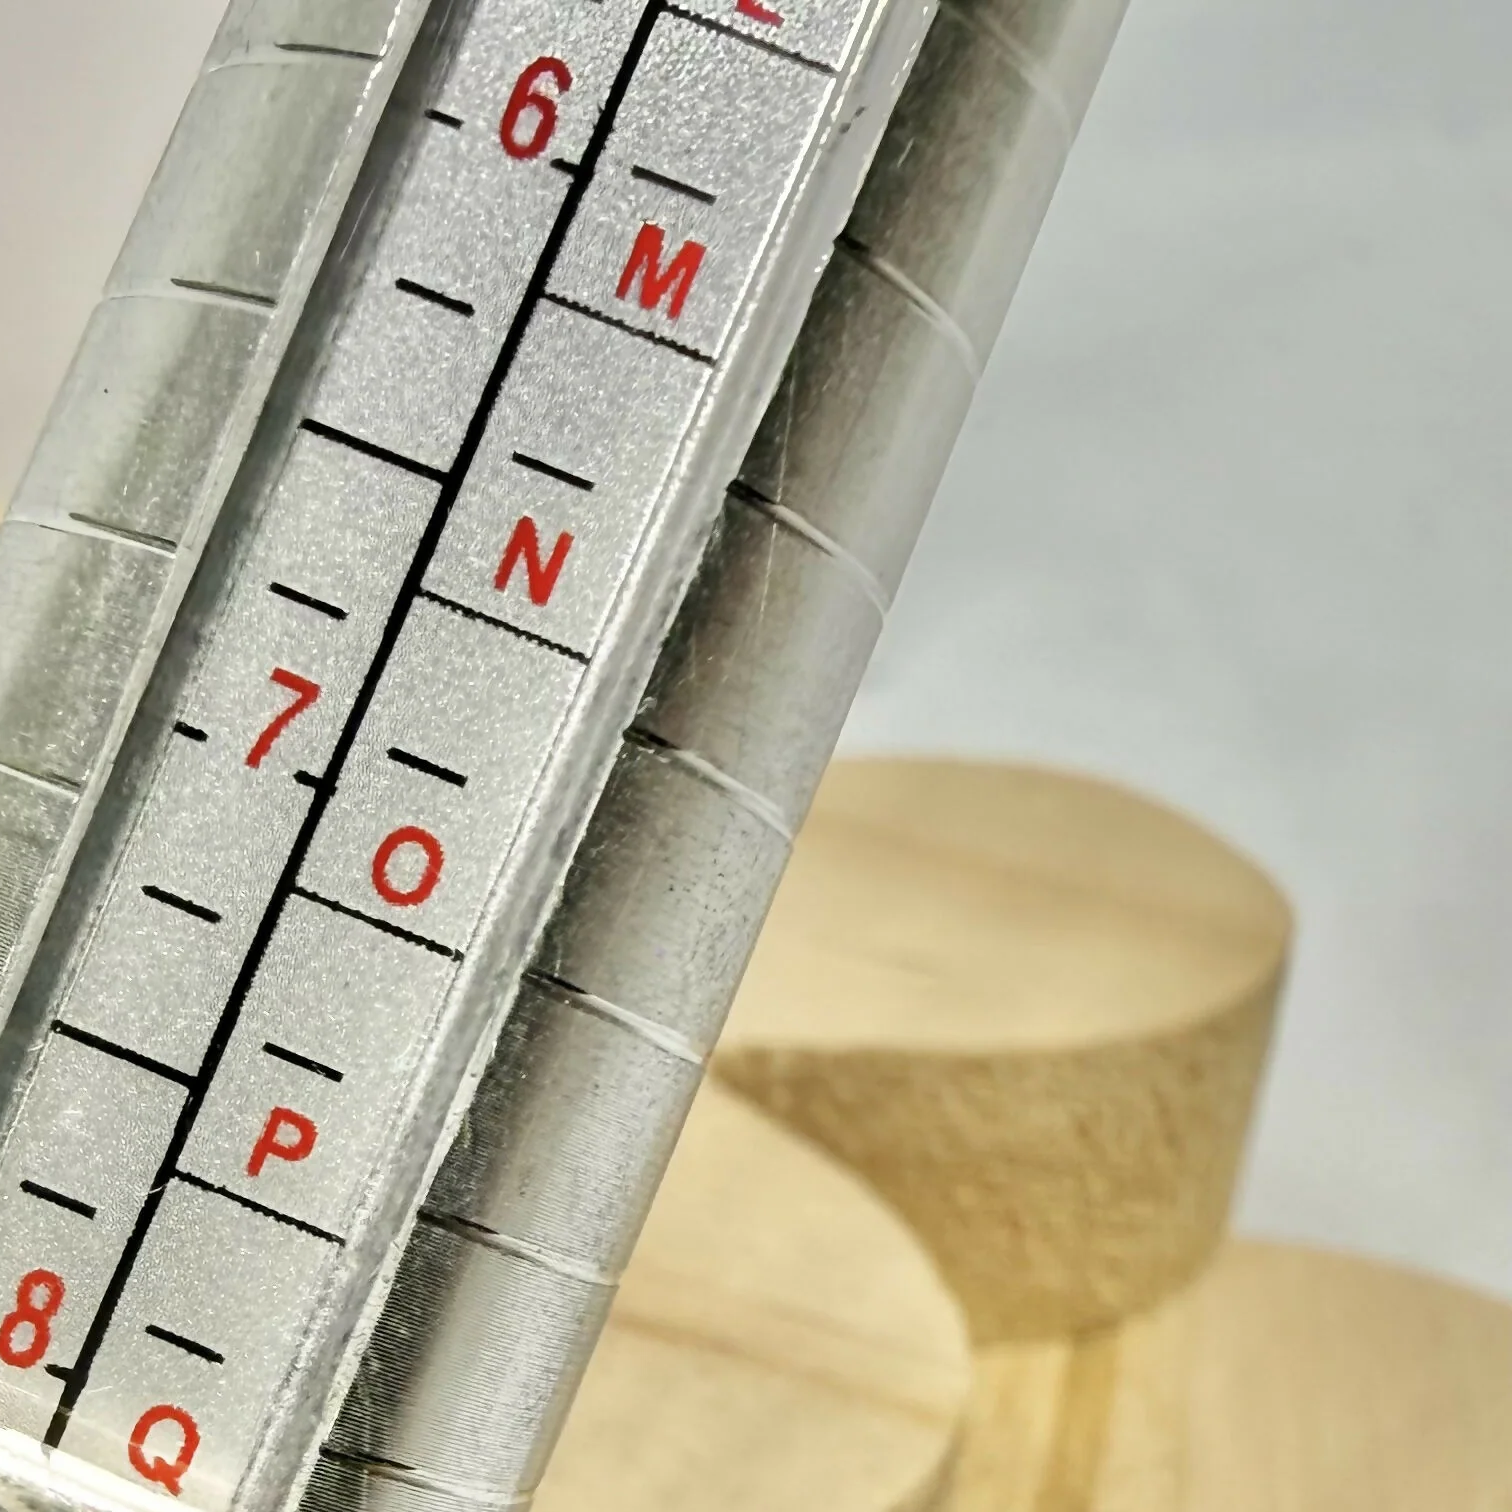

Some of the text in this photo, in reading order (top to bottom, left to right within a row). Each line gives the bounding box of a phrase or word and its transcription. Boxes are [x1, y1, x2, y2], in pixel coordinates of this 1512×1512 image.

[500, 56, 571, 159] 6
[616, 222, 706, 319] M
[494, 516, 573, 606] N
[245, 667, 320, 768] 7
[371, 825, 445, 907] O
[247, 1106, 318, 1177] P
[127, 1404, 201, 1496] Q
